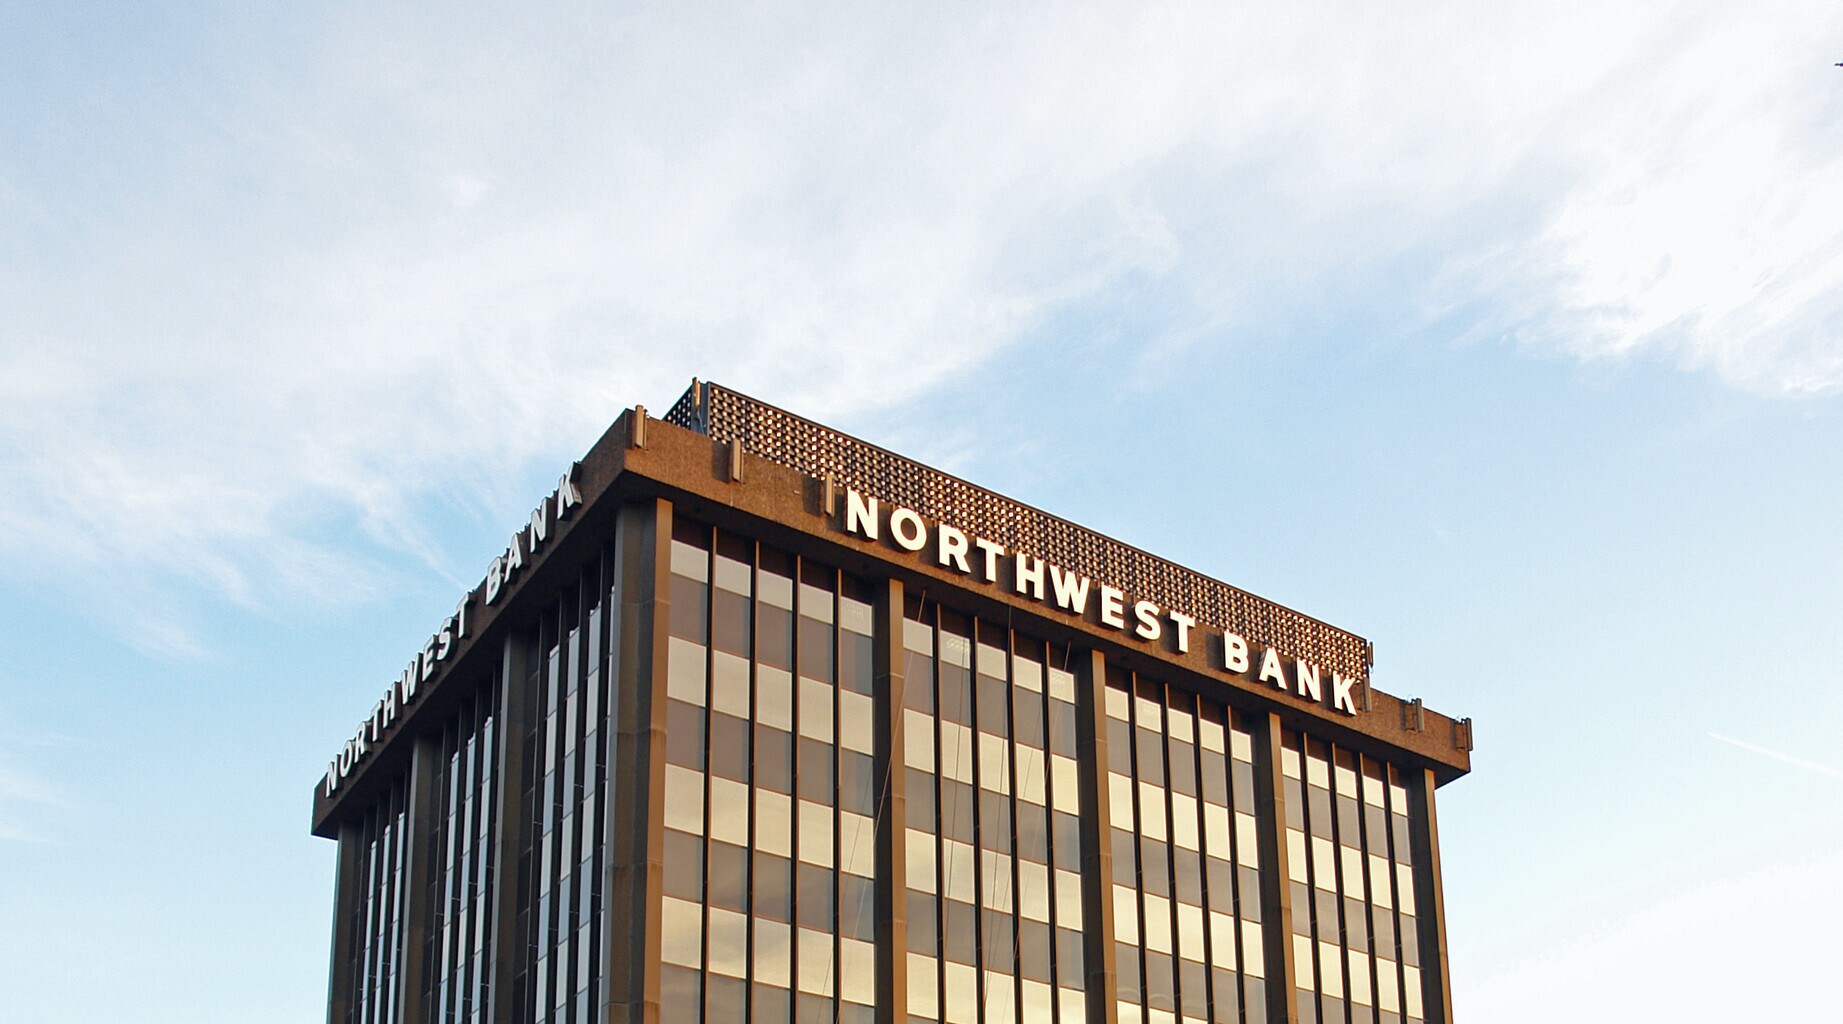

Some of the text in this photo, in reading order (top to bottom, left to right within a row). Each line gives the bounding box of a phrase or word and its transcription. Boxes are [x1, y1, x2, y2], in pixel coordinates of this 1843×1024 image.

[326, 461, 576, 798] NORTHWEST BANK
[846, 486, 1357, 716] NORTHWEST BANK
